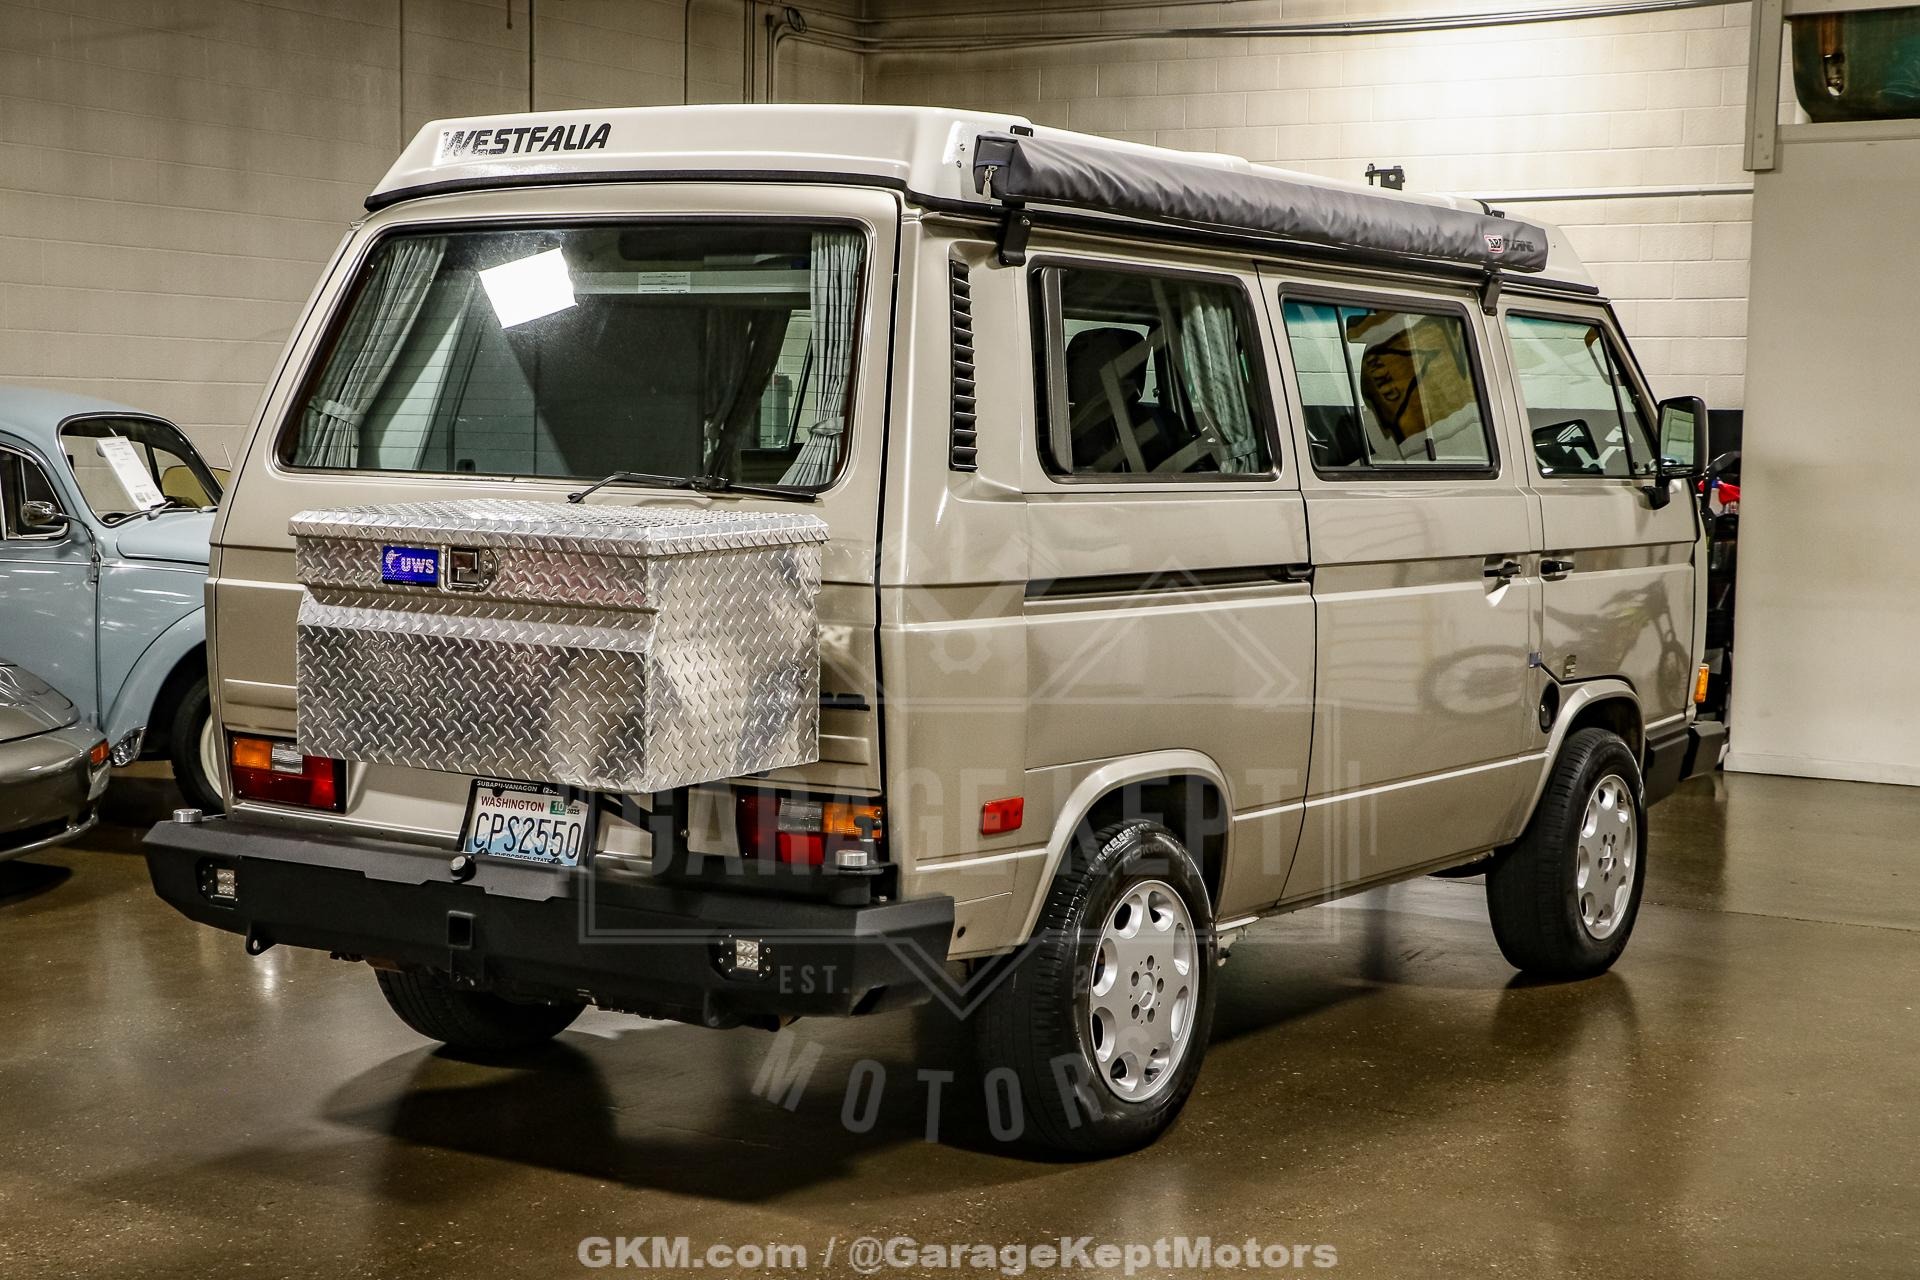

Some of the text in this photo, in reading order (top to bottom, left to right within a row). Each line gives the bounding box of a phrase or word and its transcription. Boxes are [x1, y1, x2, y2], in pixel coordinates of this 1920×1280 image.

[442, 123, 612, 158] WESTFALIA
[400, 556, 434, 575] UWS
[481, 796, 545, 813] WASHINGTON
[553, 801, 564, 812] 10
[566, 807, 580, 816] 2025
[473, 812, 582, 860] CPS2550
